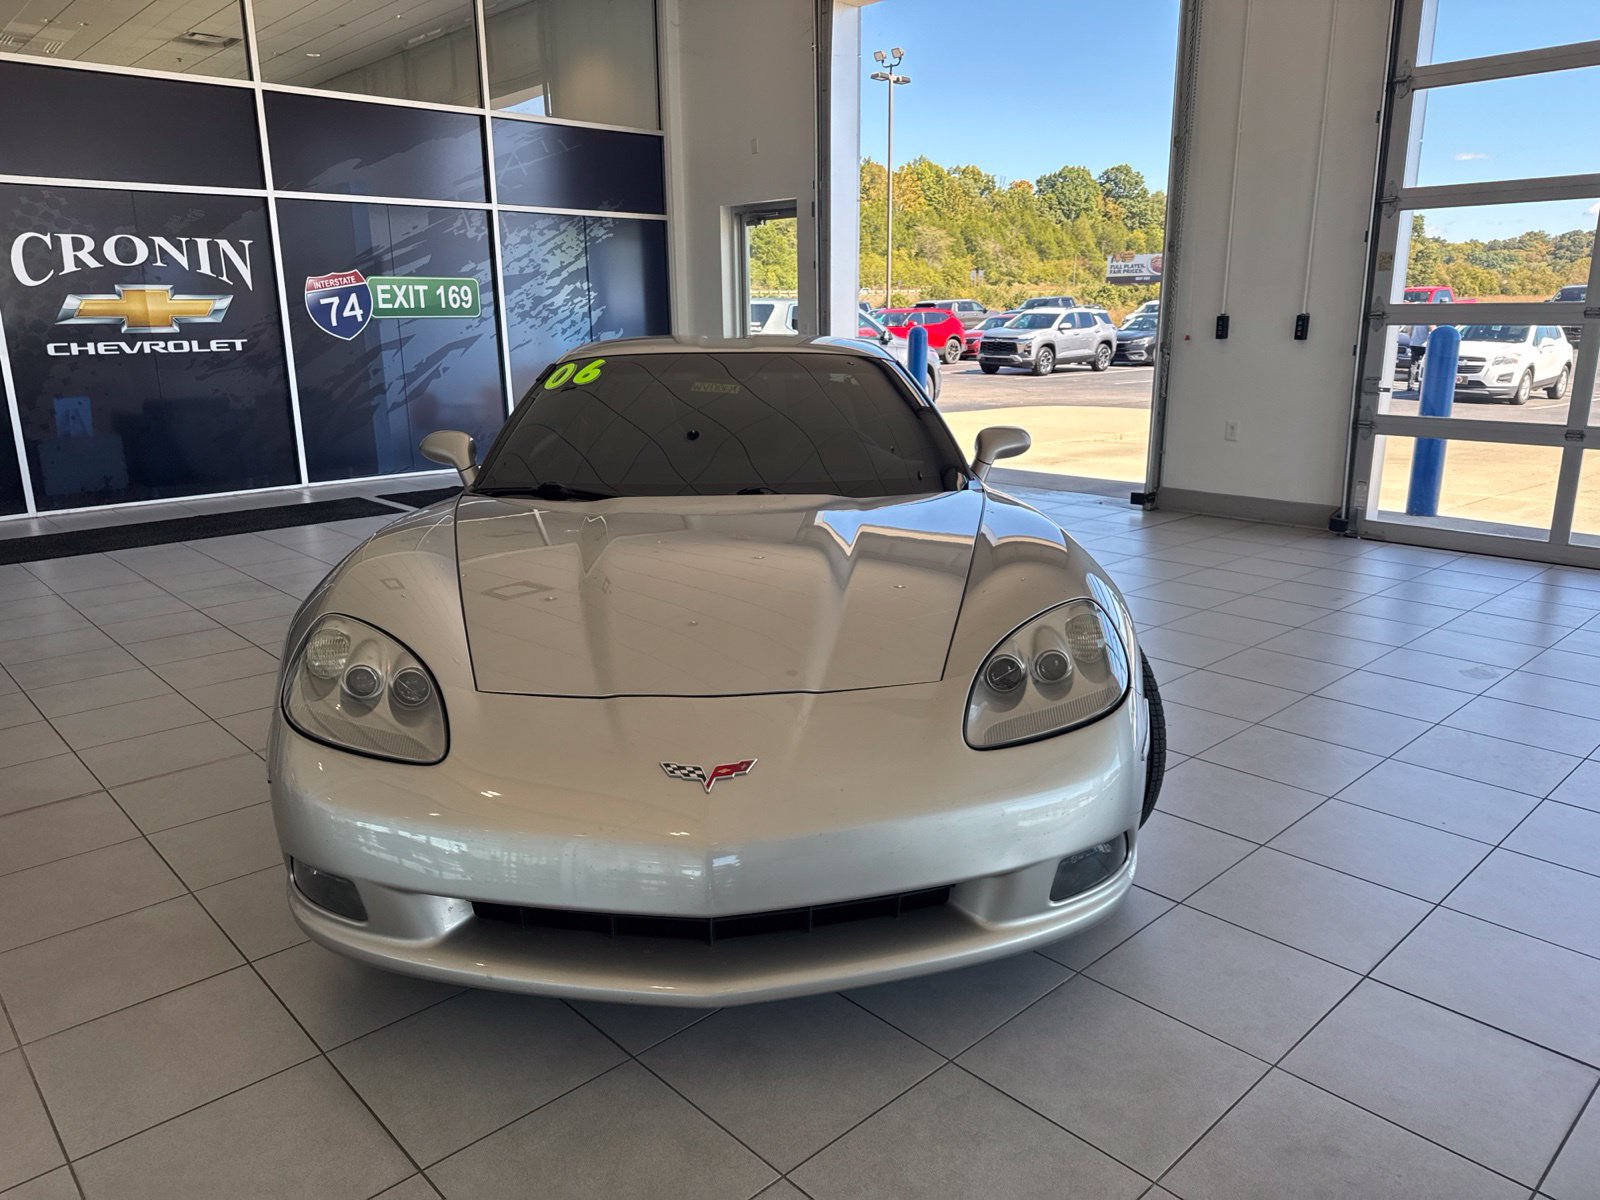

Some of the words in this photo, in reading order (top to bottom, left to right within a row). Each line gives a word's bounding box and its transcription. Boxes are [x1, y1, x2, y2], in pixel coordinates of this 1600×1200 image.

[10, 231, 254, 292] CRONIN
[313, 275, 357, 289] INTERSTATE
[376, 284, 428, 309] EXIT
[436, 284, 473, 309] 169
[319, 292, 364, 327] 74
[46, 338, 248, 357] CHEVROLET
[543, 358, 607, 391] 06
